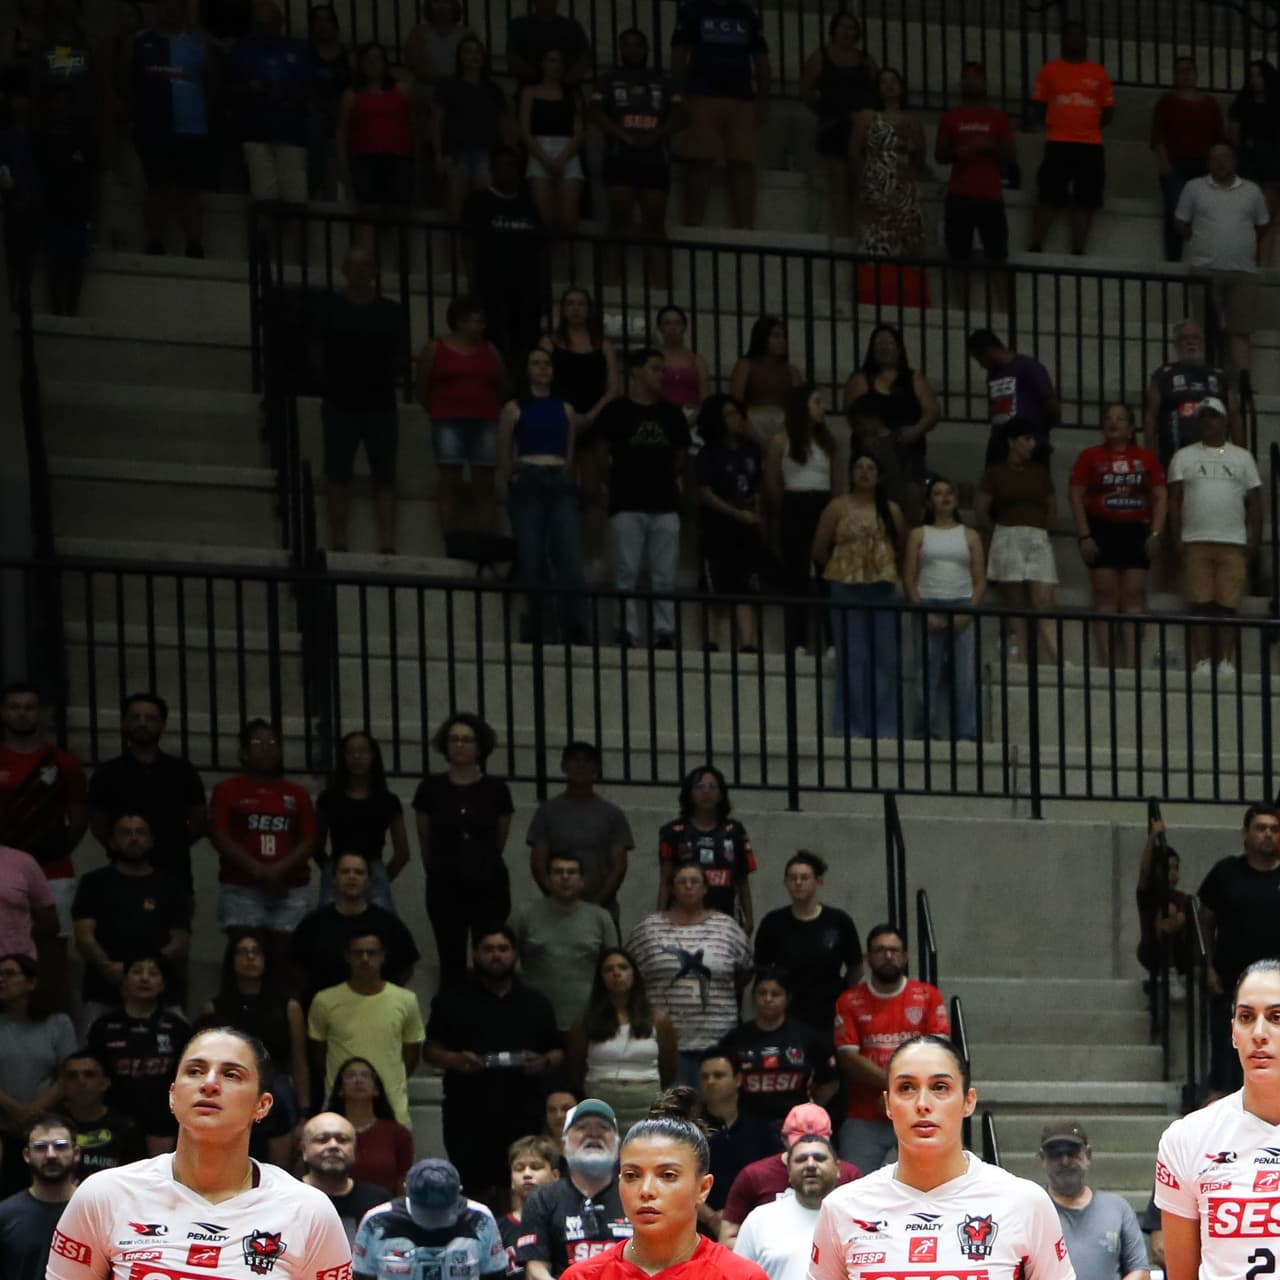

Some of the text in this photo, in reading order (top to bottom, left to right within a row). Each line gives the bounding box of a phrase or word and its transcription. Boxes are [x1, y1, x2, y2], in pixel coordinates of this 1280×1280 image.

[624, 113, 657, 129] SESI
[1102, 472, 1143, 485] SESI
[248, 813, 290, 832] SESI
[259, 834, 277, 857] 18
[746, 1074, 799, 1092] SESI
[906, 1223, 943, 1231] PENALTY
[187, 1232, 229, 1241] PENALTY
[574, 1242, 616, 1263] SES
[963, 1246, 989, 1254] SESI
[245, 1255, 273, 1271] SESI
